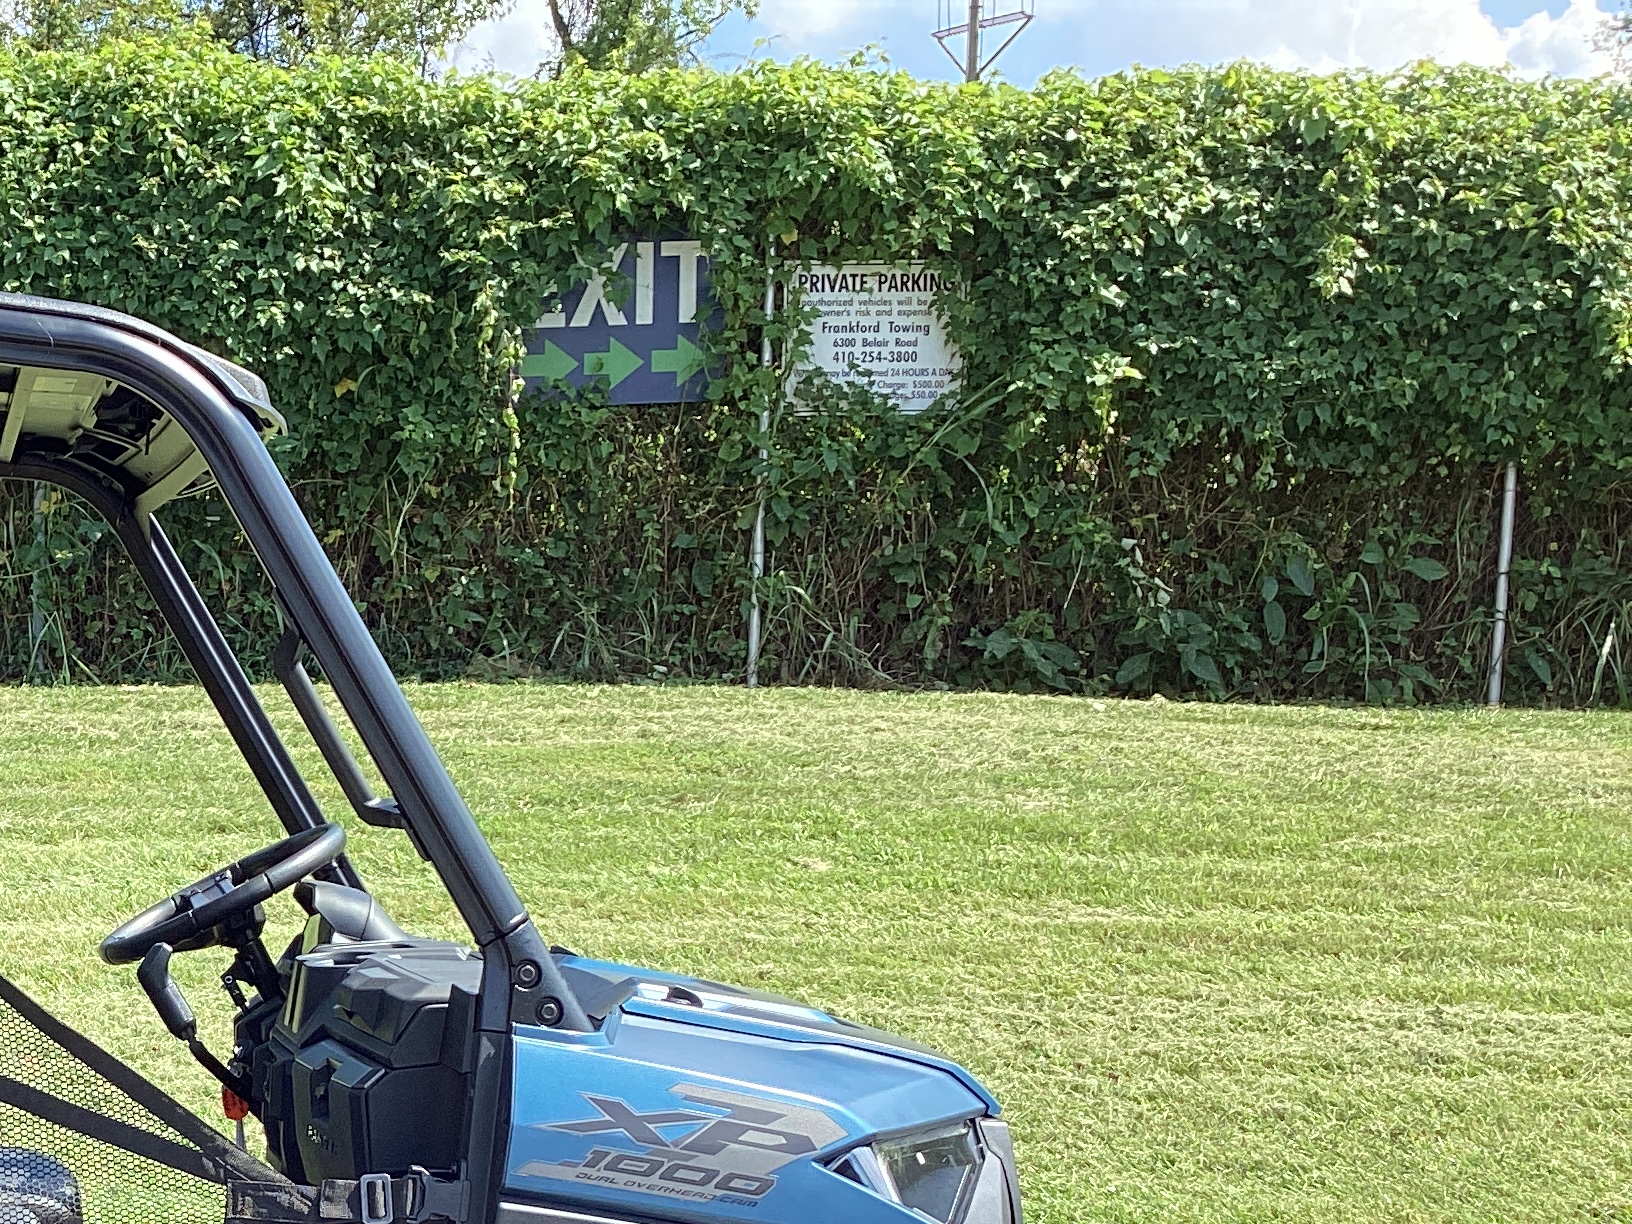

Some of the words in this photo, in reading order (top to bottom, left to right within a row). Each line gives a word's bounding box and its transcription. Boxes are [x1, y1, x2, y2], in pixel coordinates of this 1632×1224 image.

[798, 273, 868, 293] PRIVATE
[858, 297, 893, 306] vehicles
[897, 297, 913, 306] will
[917, 297, 928, 306] be
[855, 308, 871, 317] risk
[875, 308, 893, 317] and
[822, 321, 880, 334] Frankford
[888, 321, 931, 336] Towing
[833, 338, 856, 348] 6300
[862, 337, 890, 348] Belair
[895, 337, 918, 348] Road
[832, 351, 918, 363] 410-254-3800
[890, 368, 900, 377] 24
[902, 368, 929, 377] HOURS
[931, 368, 937, 377] A
[877, 380, 909, 390] Charge:
[530, 1091, 819, 1156] XP
[582, 1148, 778, 1197] 1000
[575, 1171, 620, 1185] DUAL
[623, 1180, 718, 1201] OVERHEAD
[719, 1195, 759, 1209] CAM
